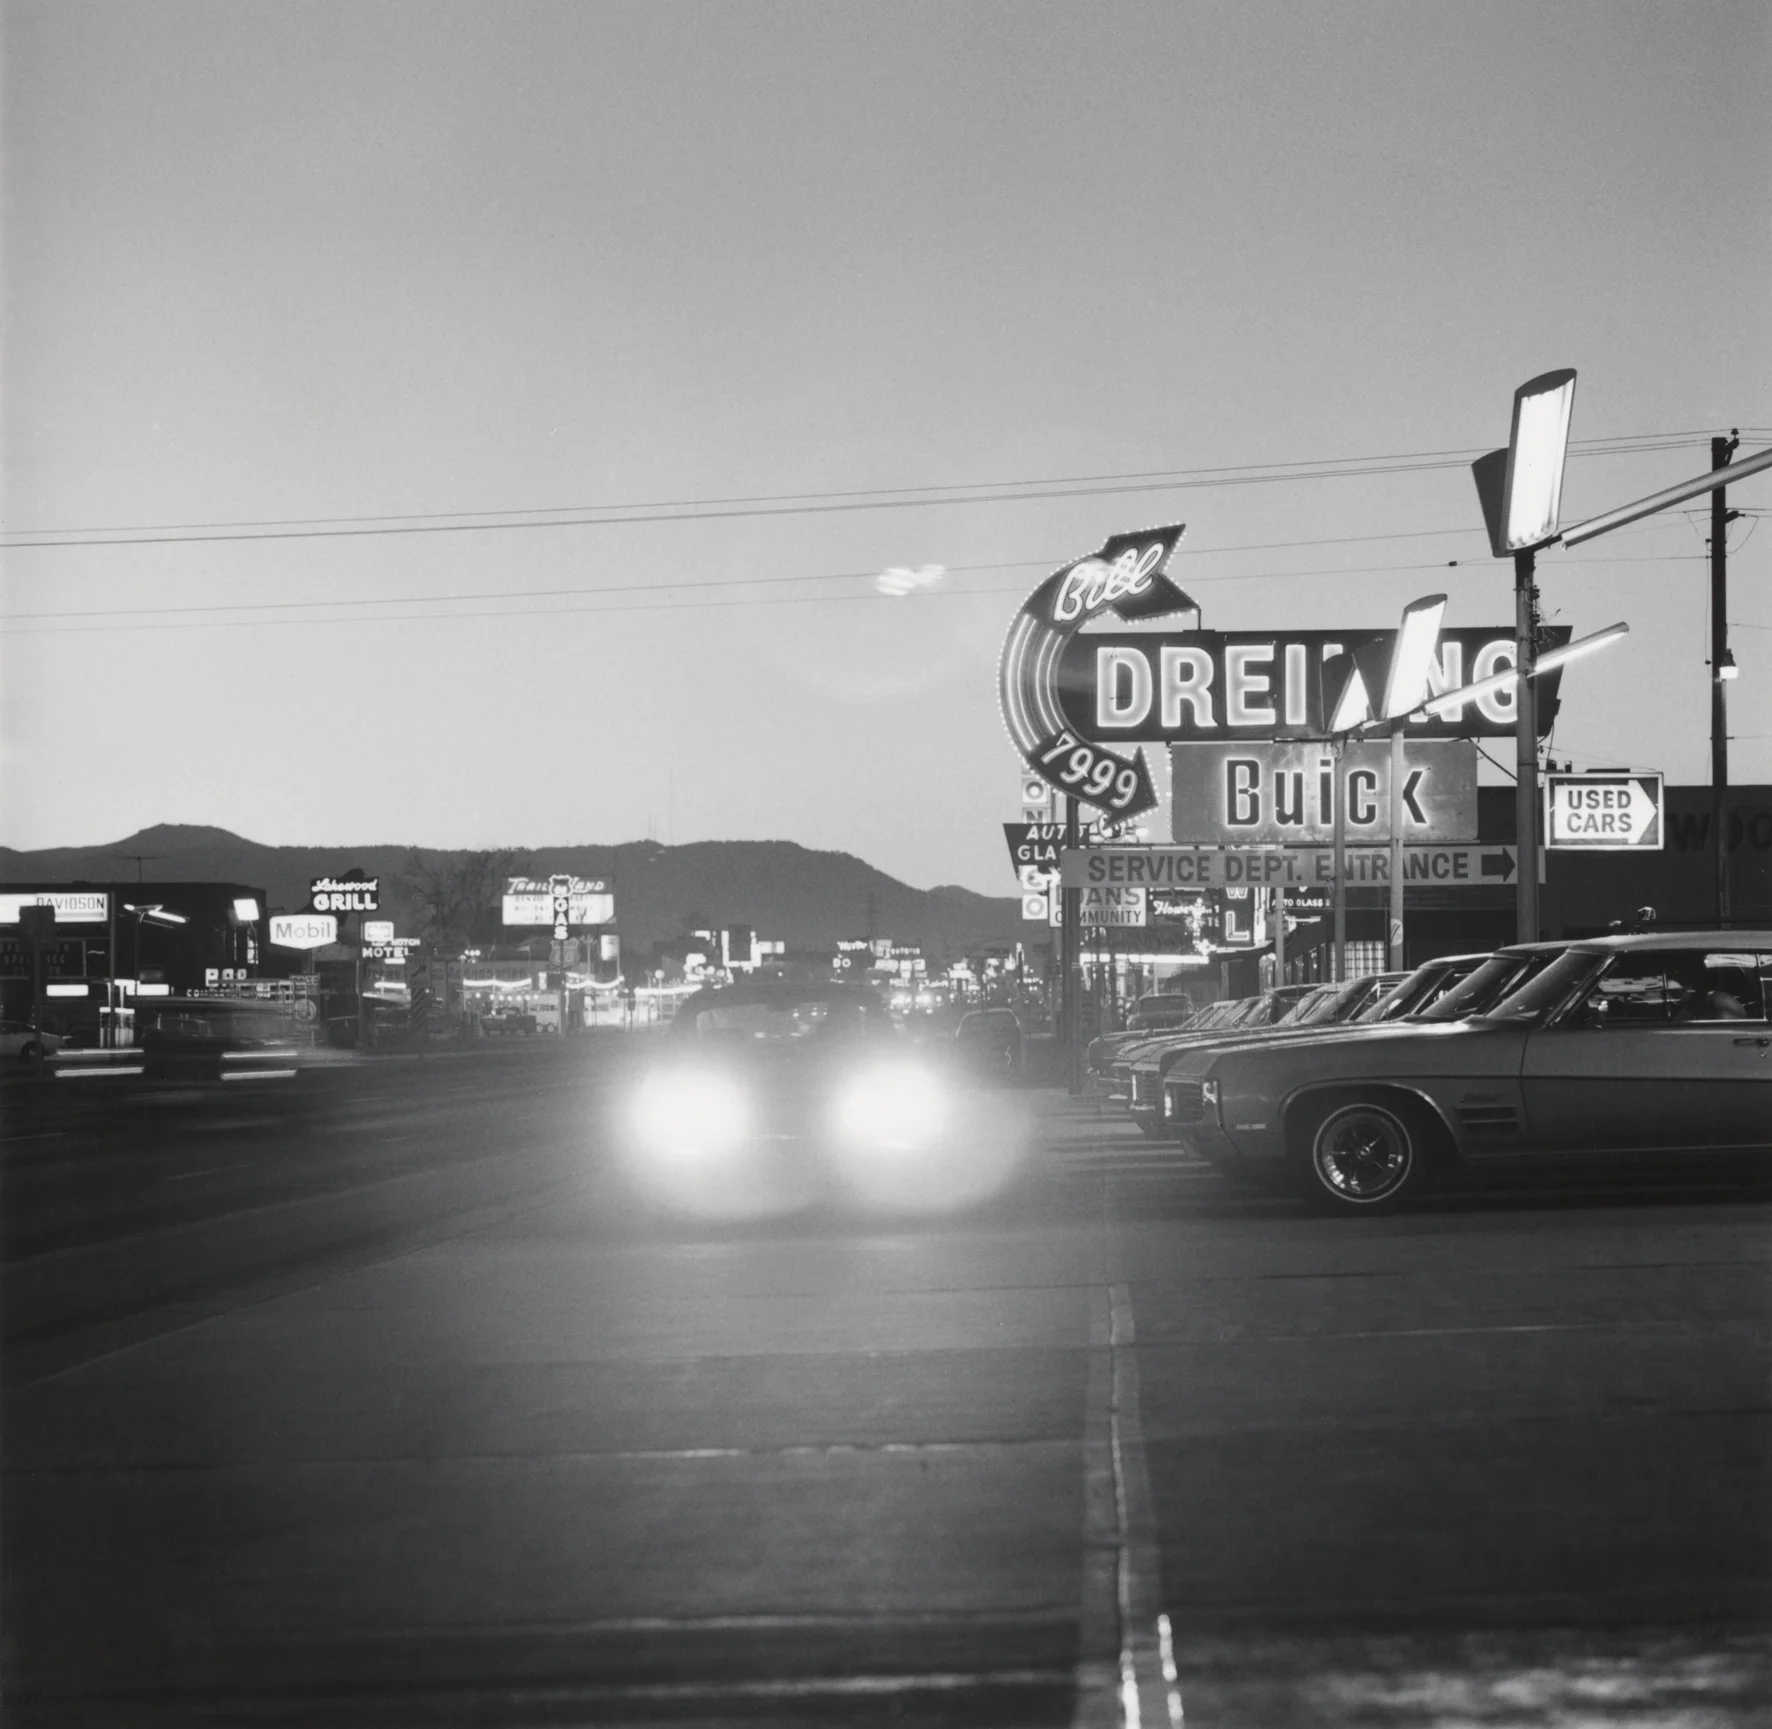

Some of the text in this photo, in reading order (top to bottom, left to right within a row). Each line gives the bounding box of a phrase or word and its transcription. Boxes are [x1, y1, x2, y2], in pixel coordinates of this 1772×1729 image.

[1053, 542, 1164, 622] Bill
[1096, 640, 1516, 728] DREING
[1039, 730, 1139, 809] 7999
[1225, 757, 1429, 827] Buick
[1567, 789, 1632, 810] USED
[1566, 812, 1633, 833] CARS
[1017, 844, 1086, 861] GLA
[1088, 852, 1469, 882] SERVICE DEPT. ENTRNCE
[36, 896, 106, 910] DAVIDSON
[312, 893, 378, 911] GRILL
[1055, 885, 1141, 906] LANS
[1271, 898, 1294, 907] ATO
[1295, 898, 1324, 907] GLASS
[553, 898, 570, 940] GAS
[275, 921, 330, 939] Mobil
[362, 946, 414, 959] MOTEL
